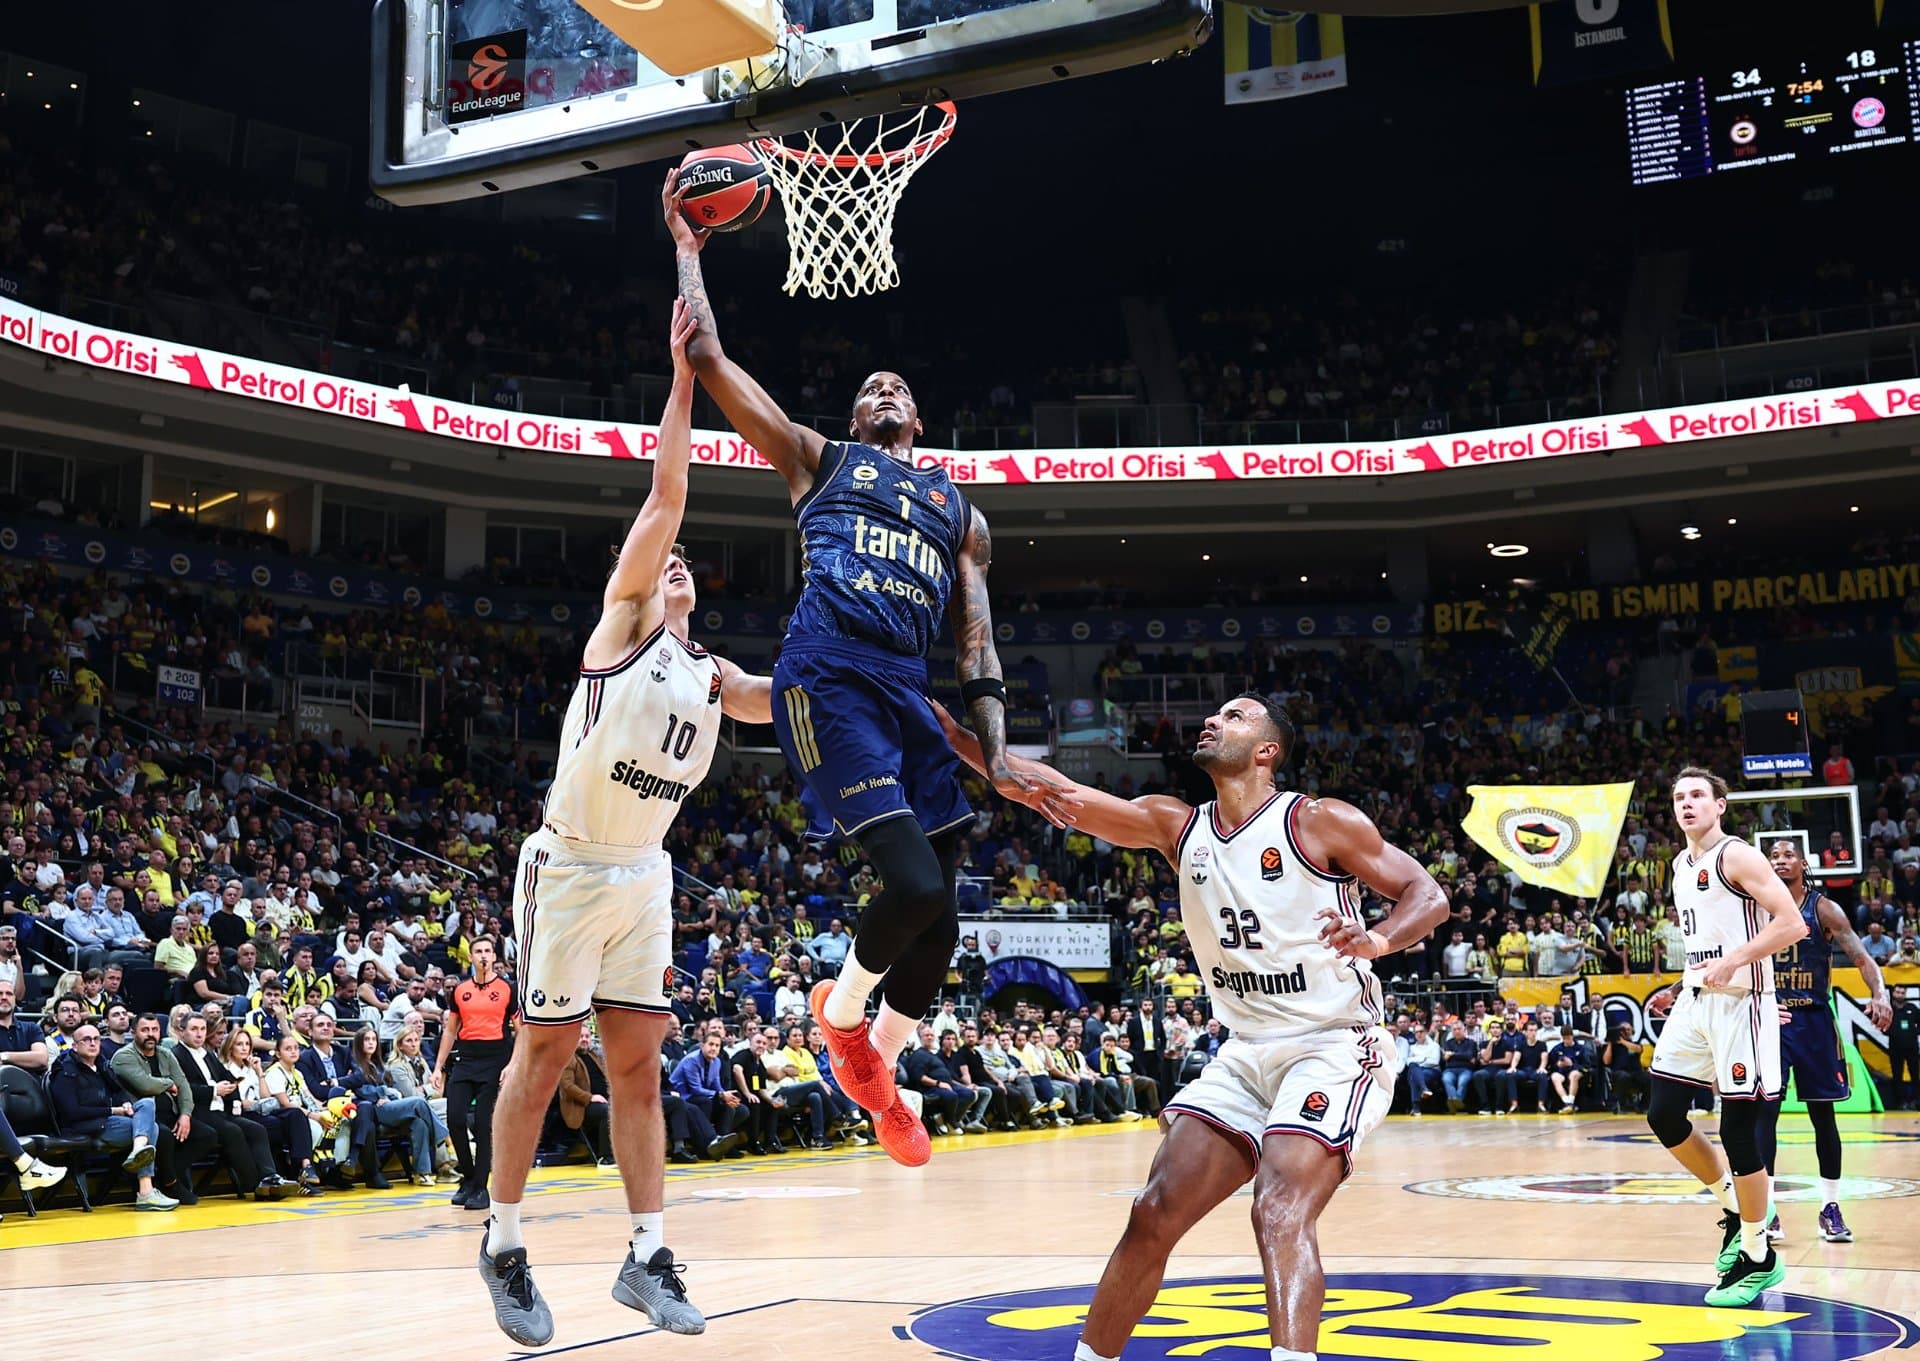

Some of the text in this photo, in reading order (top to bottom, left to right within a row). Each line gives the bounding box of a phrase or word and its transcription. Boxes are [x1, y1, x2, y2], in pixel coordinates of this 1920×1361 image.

[1846, 50, 1876, 69] 18
[1731, 68, 1761, 88] 34
[1787, 79, 1824, 96] 7:54
[1842, 84, 1850, 94] 1
[452, 89, 522, 114] EuroLeague
[1763, 96, 1773, 107] 2
[1802, 125, 1817, 135] VS
[1842, 140, 1873, 152] BAYERN
[1874, 135, 1906, 148] MUNICH
[86, 334, 158, 374] Ofisi
[222, 361, 377, 418] Petrol Ofisi
[1785, 376, 1813, 390] 420
[494, 391, 515, 406] 401
[433, 405, 581, 451] Petrol Ofisi
[1421, 417, 1443, 432] 421
[1669, 406, 1757, 439] Petrol
[640, 432, 721, 463] Prol
[1452, 423, 1609, 464] Petrol Ofisi
[1034, 454, 1186, 480] Petrol Ofisi
[1243, 448, 1394, 476] Petrol Ofisi
[852, 481, 874, 491] tarfin
[898, 494, 911, 521] 1
[854, 515, 943, 584] tarfin
[175, 671, 195, 685] 202
[1802, 670, 1857, 693] UNI
[175, 687, 196, 701] 102
[300, 706, 324, 718] 202
[1786, 711, 1798, 726] 4
[661, 712, 697, 761] 10
[1746, 758, 1805, 771] Limak Hotels
[840, 781, 867, 800] Limak
[1220, 907, 1264, 950] 32
[1683, 907, 1697, 937] 31
[1009, 947, 1095, 956] YEMEK KARTI
